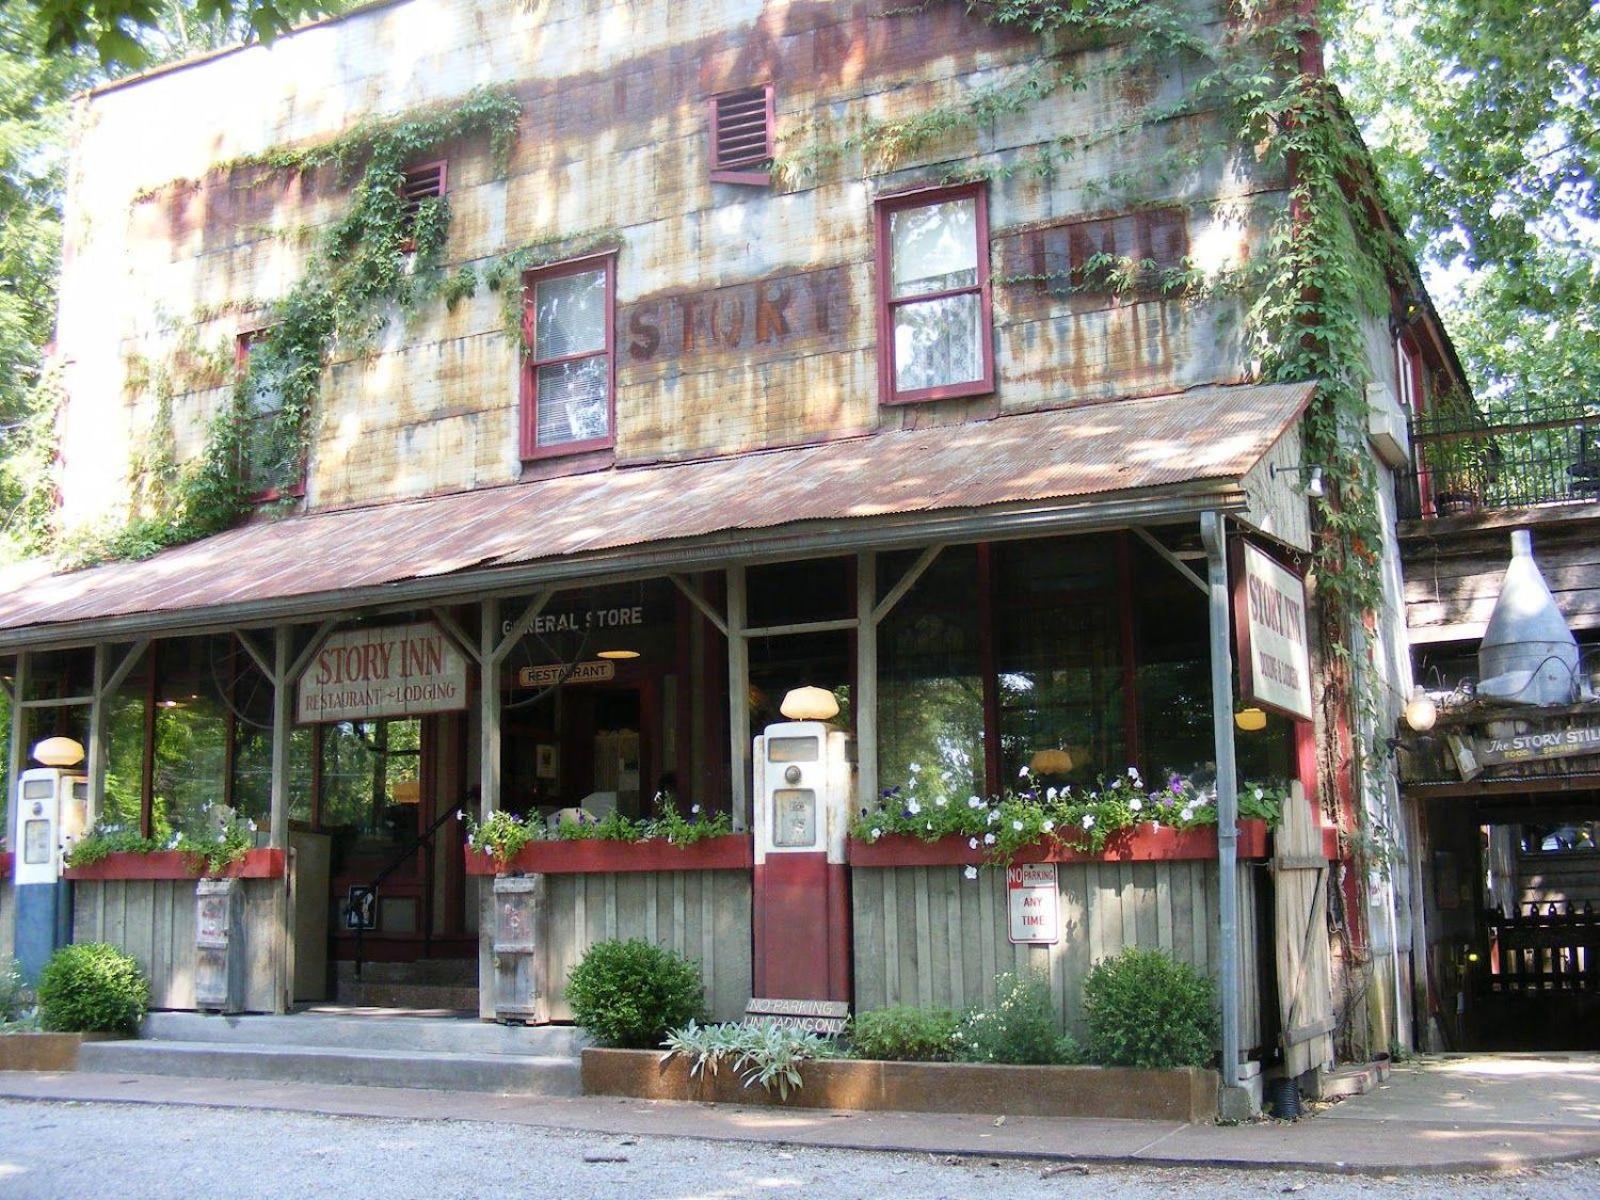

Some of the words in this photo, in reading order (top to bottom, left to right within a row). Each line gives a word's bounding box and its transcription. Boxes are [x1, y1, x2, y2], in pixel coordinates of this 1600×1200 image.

[628, 272, 838, 361] STORY
[1249, 573, 1284, 637] STORY
[502, 612, 579, 636] GNERAL
[585, 607, 643, 629] STORE
[316, 639, 397, 685] STORY
[400, 635, 443, 678] INN
[527, 664, 608, 682] RESTARANT
[305, 688, 382, 711] RESTAURANT
[397, 682, 458, 703] LODGING
[1485, 740, 1509, 753] The
[1512, 732, 1561, 750] STORY
[1566, 728, 1600, 744] STIL
[1008, 867, 1023, 883] NO
[1024, 870, 1054, 881] PARKING
[1023, 896, 1043, 907] ANY
[1020, 915, 1045, 926] TIME
[748, 999, 770, 1012] NO
[772, 999, 833, 1015] PARKING
[815, 1017, 847, 1033] ONLY
